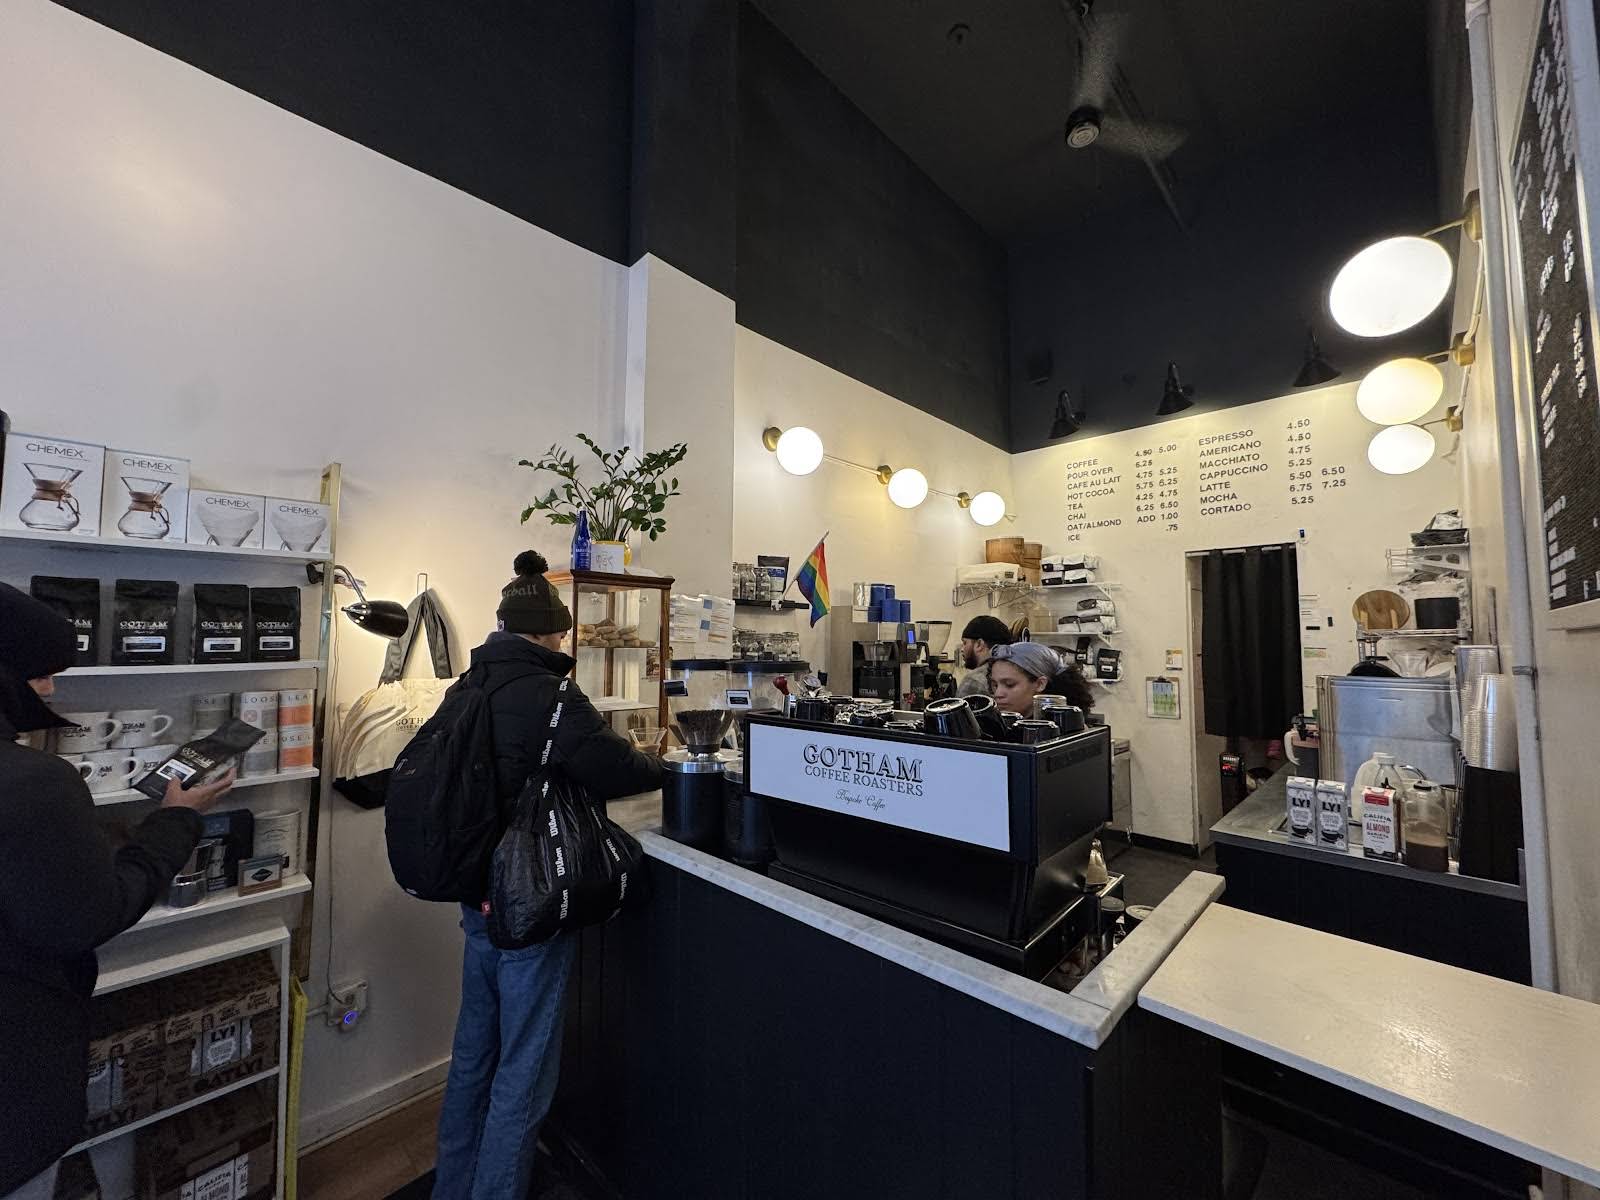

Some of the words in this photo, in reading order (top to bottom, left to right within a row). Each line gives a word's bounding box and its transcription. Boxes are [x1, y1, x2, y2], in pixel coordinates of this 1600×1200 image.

[1199, 429, 1253, 446] ESPRESSO
[1286, 418, 1310, 429] 4.50
[26, 442, 84, 459] CHEMEX
[1199, 440, 1262, 457] AMERICANO
[1287, 432, 1311, 443] 4.50
[122, 458, 173, 471] CHEMEX
[1066, 459, 1098, 470] COFFEE
[1158, 444, 1177, 454] 5.00
[1199, 453, 1260, 469] MACCHIATO
[1288, 444, 1311, 455] 4.75
[1067, 470, 1089, 480] POUR
[1090, 466, 1114, 476] OVER
[1067, 481, 1088, 490] CAFE
[1090, 477, 1101, 487] AU
[1103, 475, 1121, 485] LAIT
[1135, 471, 1153, 479] 4.75
[1159, 467, 1178, 476] 5.25
[1199, 463, 1268, 481] CAPPUCCINO
[1288, 457, 1312, 468] 5.25
[1199, 481, 1231, 492] LATTE
[1289, 470, 1312, 481] 5.50
[1321, 466, 1345, 476] 6.50
[1067, 492, 1083, 501] HOT
[1085, 487, 1115, 498] COCOA
[1136, 481, 1153, 490] 5.75
[1159, 478, 1178, 487] 6.25
[1067, 503, 1083, 511] TEA
[1136, 493, 1153, 502] 4.25
[1159, 489, 1178, 498] 4.75
[1200, 492, 1238, 504] MOCHA
[1289, 483, 1312, 493] 6.75
[1321, 479, 1346, 489] 7.25
[205, 497, 250, 508] CHEMEX
[279, 505, 320, 516] CHEMEX
[1067, 513, 1086, 521] CHAI
[1136, 503, 1154, 512] 6.25
[1160, 501, 1179, 509] 6.50
[1200, 503, 1251, 516] CORTADO
[1291, 496, 1314, 505] 5.25
[1067, 518, 1122, 531] OAT/ALMOND
[1137, 514, 1156, 523] ADD
[1161, 511, 1179, 520] 1.00
[1067, 533, 1080, 542] ICE
[1165, 524, 1178, 532] .75
[396, 717, 424, 726] GOTH
[549, 702, 563, 728] Wilson
[541, 740, 552, 765] Wilson
[803, 743, 923, 783] GOTHAM
[805, 765, 850, 783] COFFEE
[853, 773, 923, 797] ROASTERS
[865, 794, 886, 812] Coffee
[1292, 797, 1310, 808] LY!
[1322, 801, 1341, 812] LY!
[548, 810, 559, 837] Wilson
[1363, 813, 1391, 822] CALIFIA
[1366, 822, 1390, 833] ALMOND
[606, 838, 620, 862] Wilson
[555, 846, 566, 877] Wilson
[560, 889, 569, 920] Wilson
[211, 1025, 236, 1042] LY!
